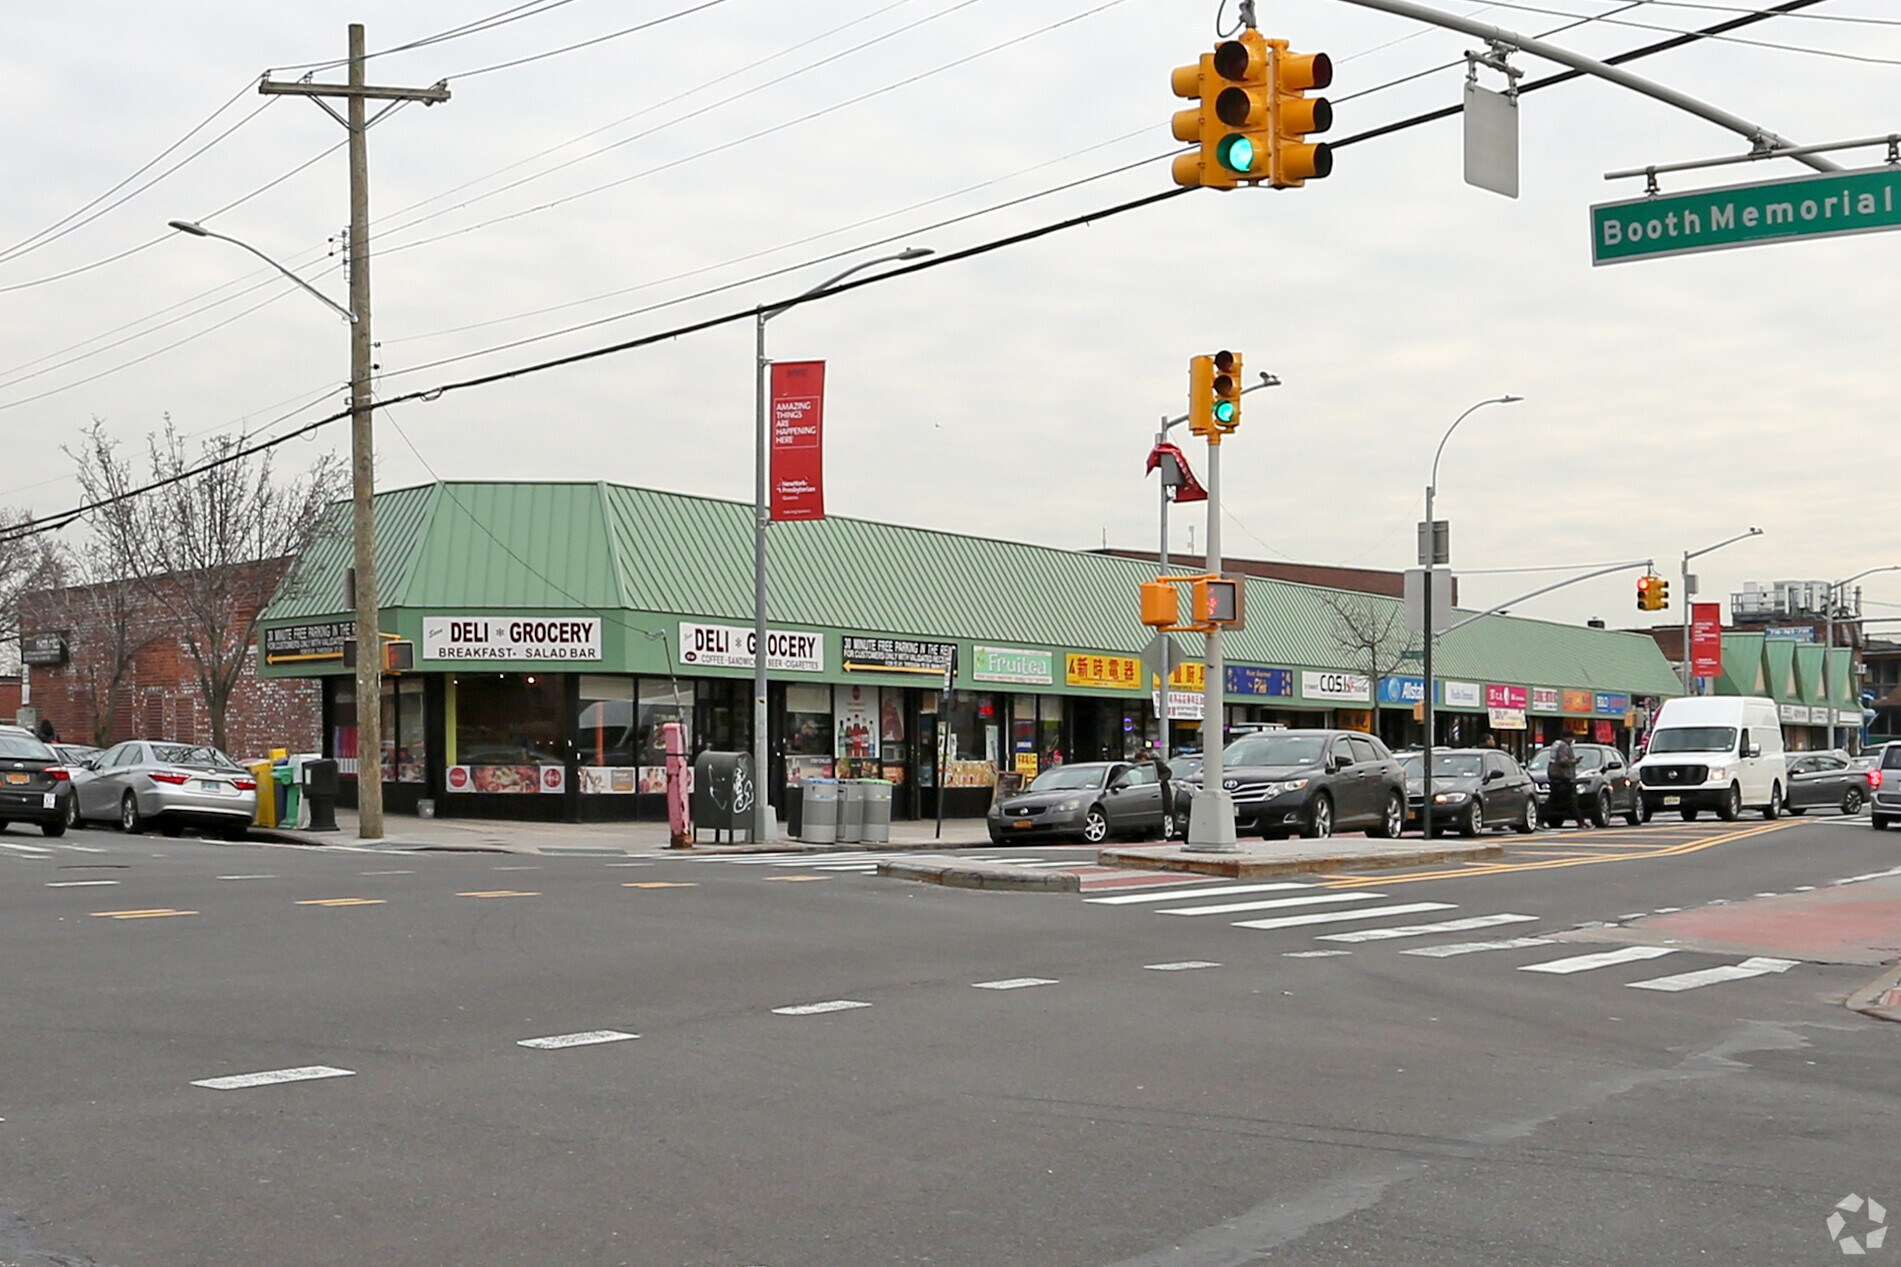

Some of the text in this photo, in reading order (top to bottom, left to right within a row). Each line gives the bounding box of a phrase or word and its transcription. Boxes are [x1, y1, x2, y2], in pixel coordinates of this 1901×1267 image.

[1603, 186, 1892, 246] Booth Memorial
[776, 401, 812, 410] AMAZING
[776, 410, 803, 419] THINGS
[776, 419, 790, 427] ARE
[776, 426, 817, 436] HAPPENING
[776, 435, 794, 444] HERE
[293, 626, 307, 639] FREE
[451, 622, 489, 643] DELI
[509, 622, 593, 643] GROCERY
[695, 628, 816, 658] DELI GOCERY
[878, 640, 893, 653] FREE
[895, 641, 918, 654] PARKING
[927, 644, 939, 655] THE
[525, 648, 566, 658] SALAD
[570, 648, 596, 658] BAR
[988, 653, 1047, 675] Fruitea
[1402, 682, 1425, 699] Allstat
